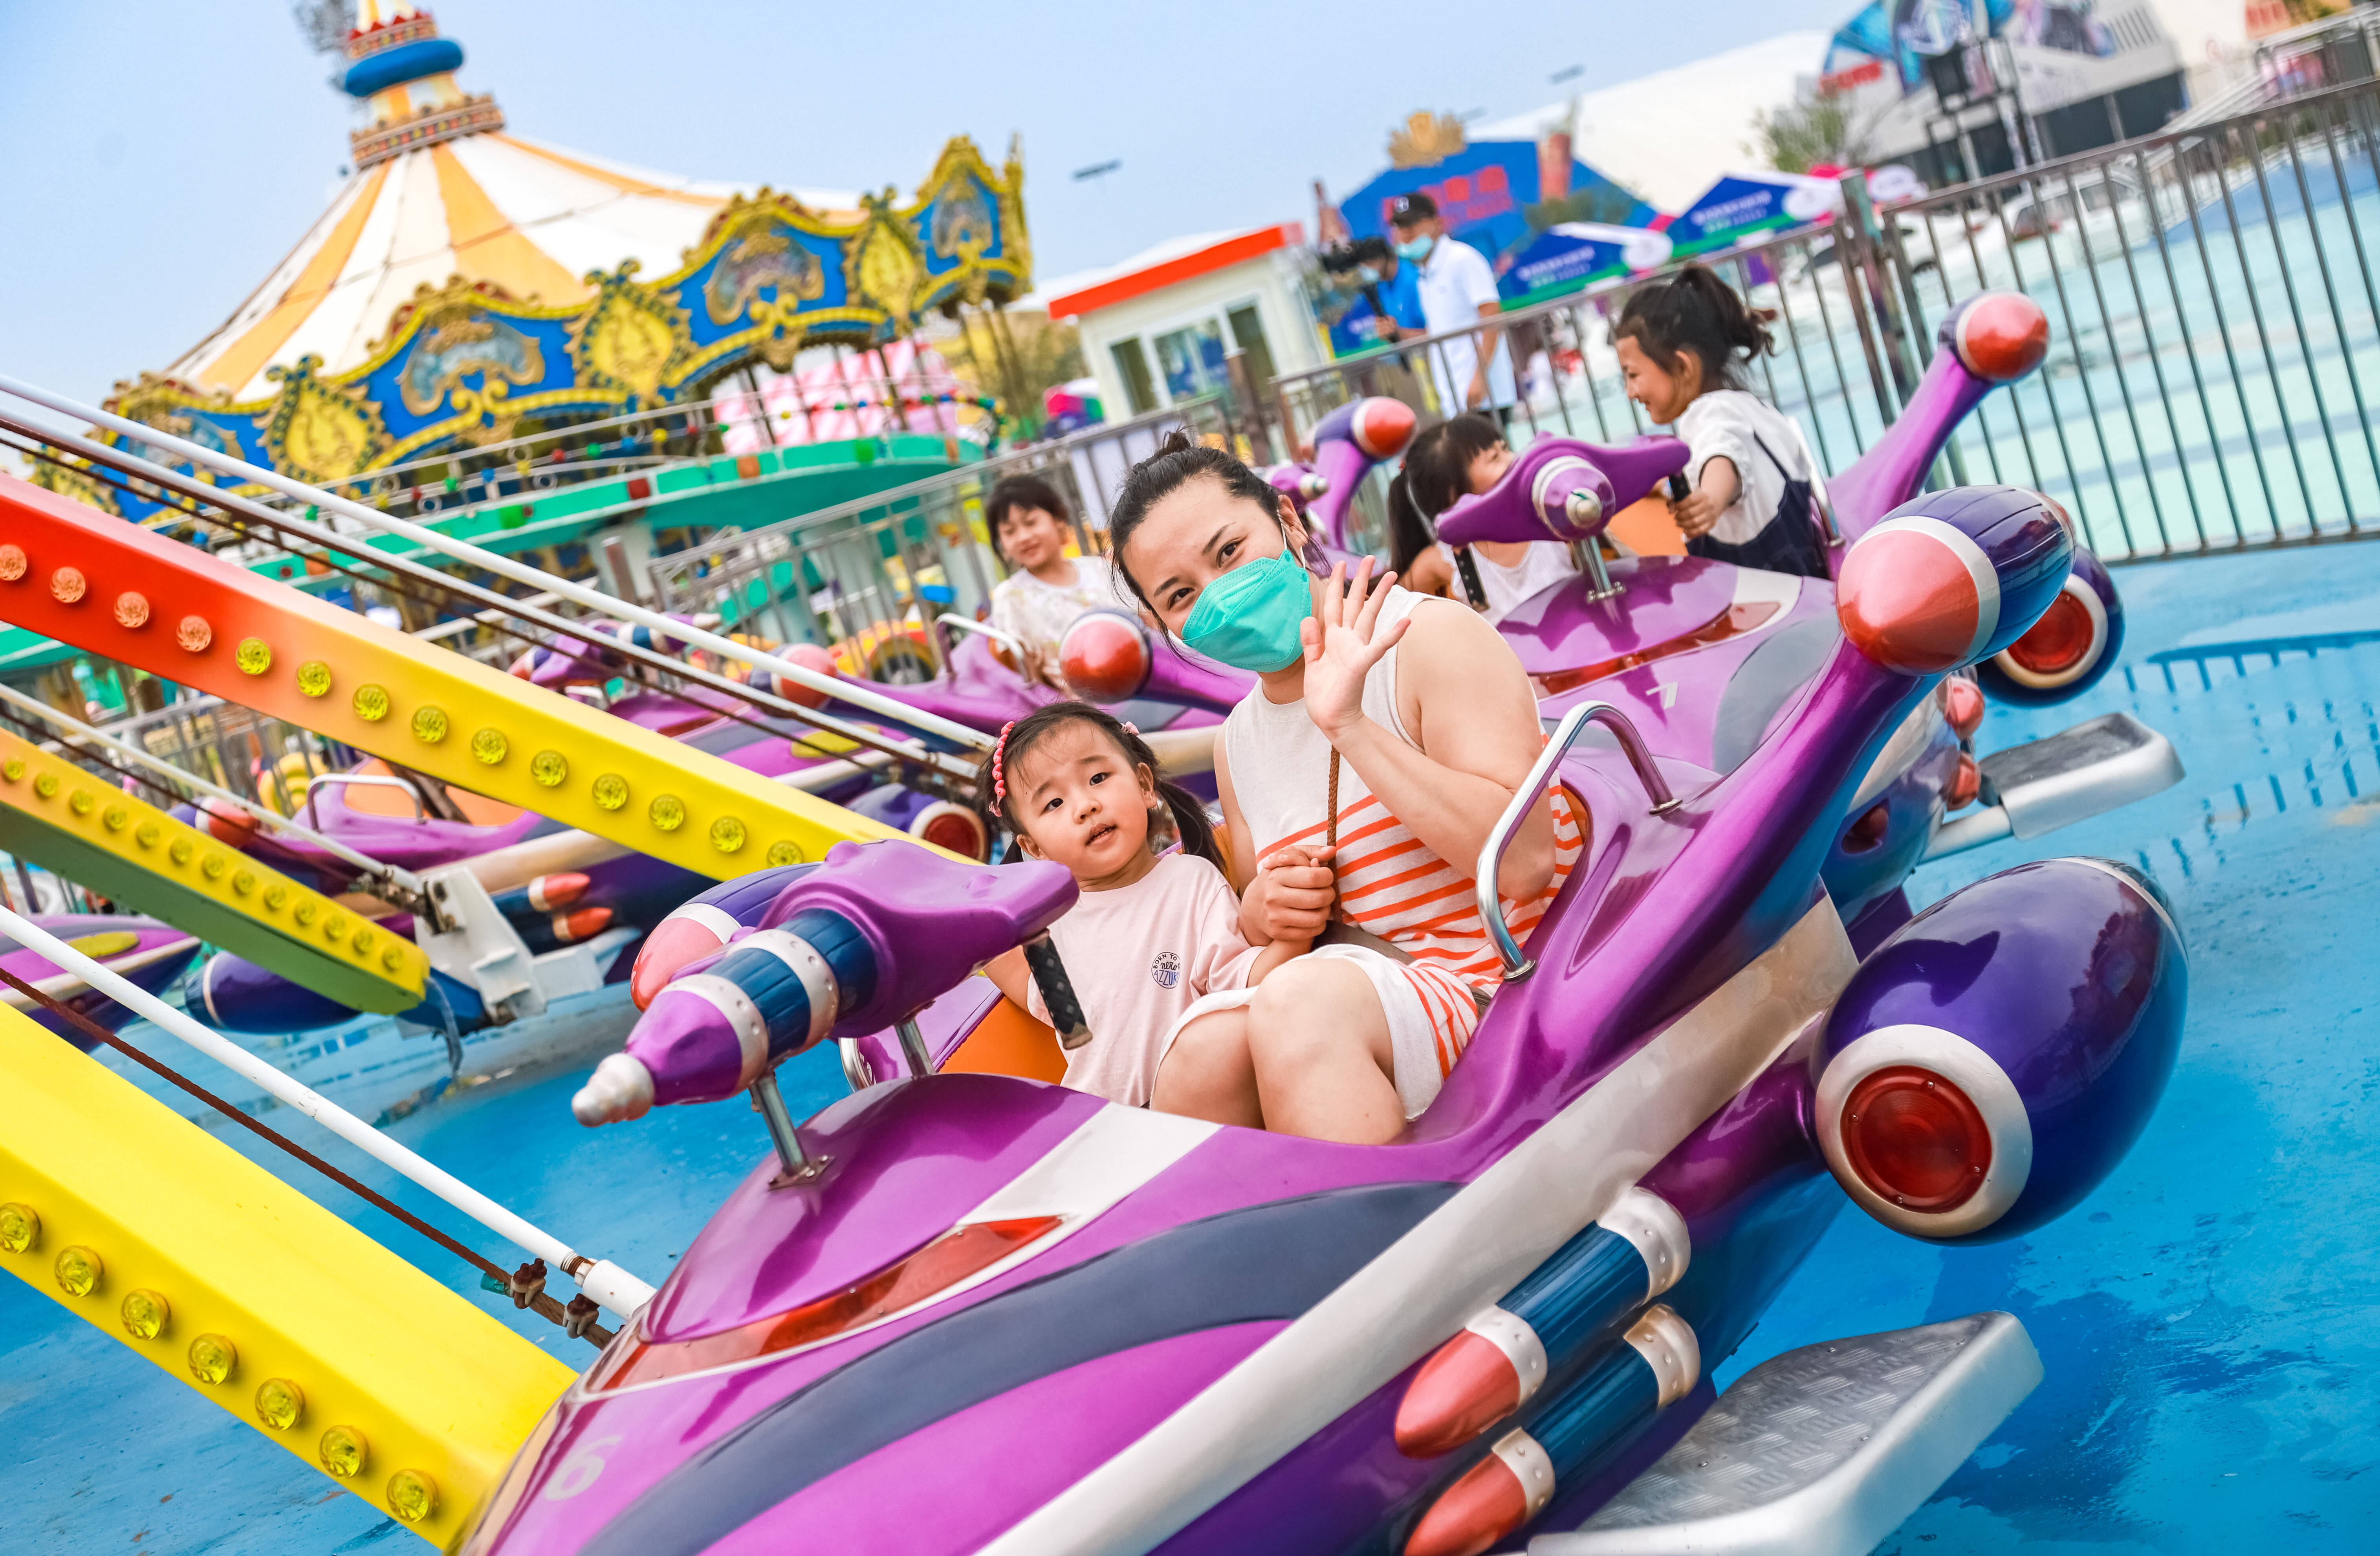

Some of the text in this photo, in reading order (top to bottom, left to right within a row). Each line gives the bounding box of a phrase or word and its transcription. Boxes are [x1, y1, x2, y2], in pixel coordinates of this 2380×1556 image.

[1153, 954, 1167, 969] BORN
[1160, 961, 1178, 971] nero
[544, 1435, 623, 1501] 6
